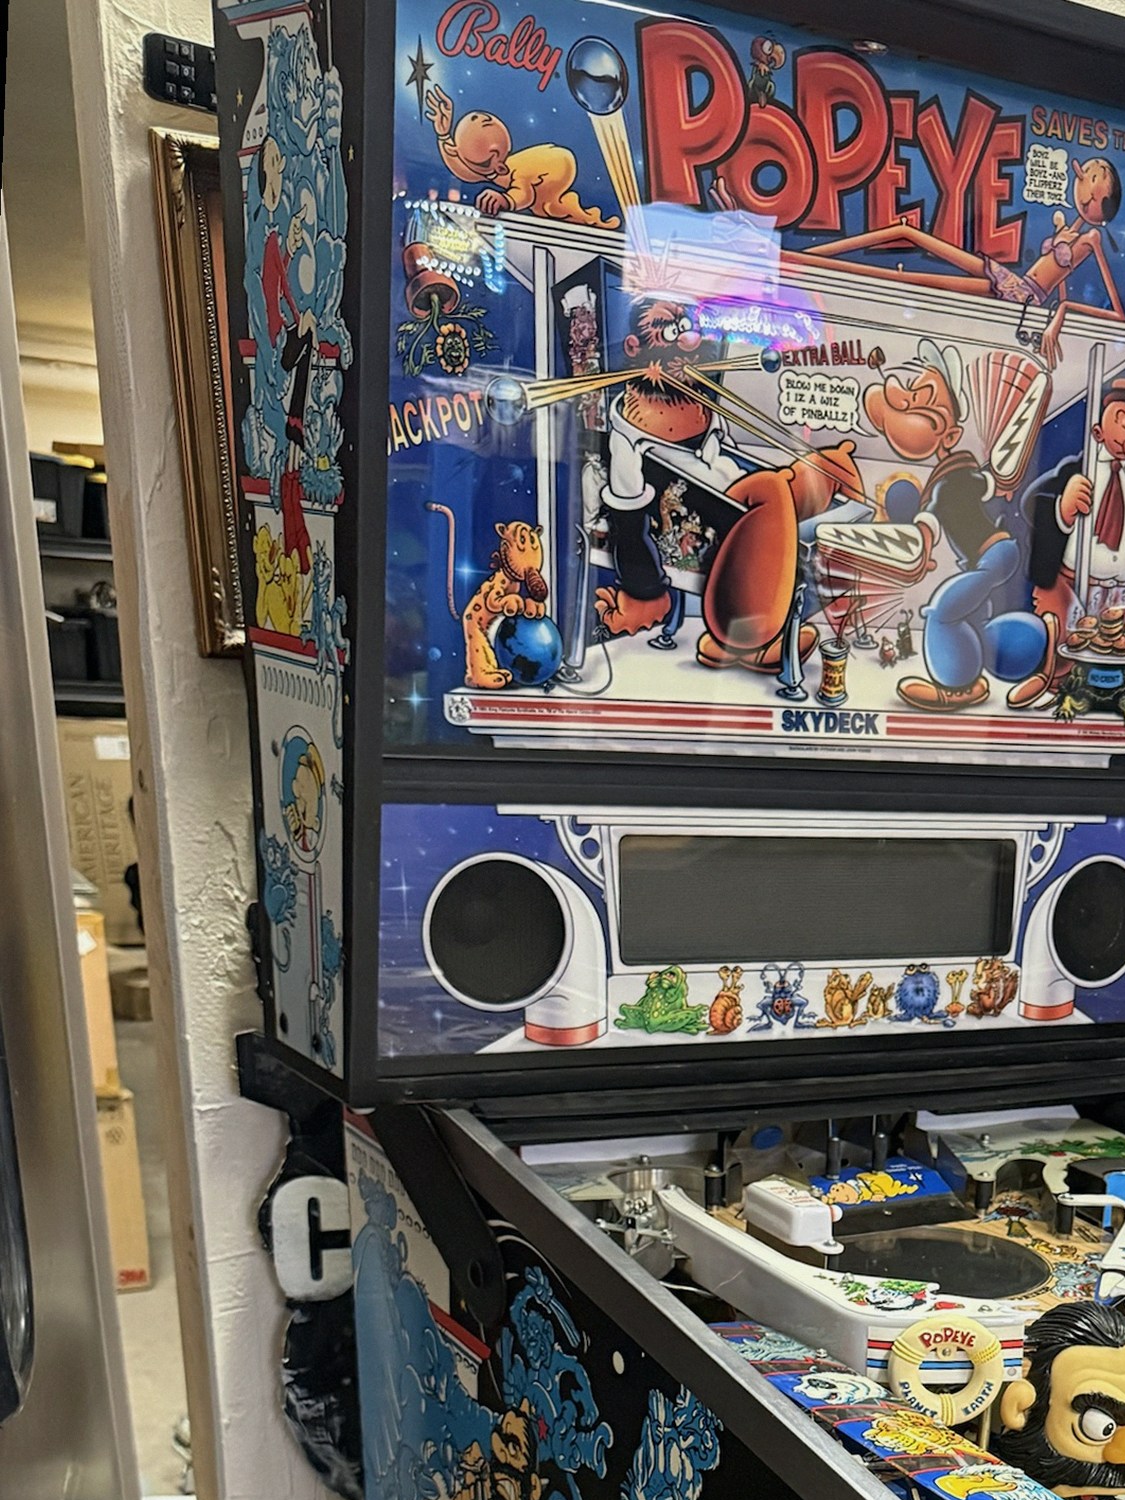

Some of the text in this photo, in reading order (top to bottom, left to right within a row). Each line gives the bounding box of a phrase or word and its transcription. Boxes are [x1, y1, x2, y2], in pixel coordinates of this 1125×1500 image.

[436, 0, 562, 92] Bally
[634, 16, 1027, 263] POPEYE
[1031, 104, 1109, 150] SAVES
[1030, 159, 1059, 171] WILL BE
[1032, 149, 1050, 160] BOYZ
[782, 338, 867, 367] EXTRA BALL
[785, 378, 856, 397] BLOW ME DOWN
[795, 392, 806, 403] IZ
[808, 394, 817, 405] A
[820, 396, 840, 408] WIZ
[782, 405, 797, 417] OF
[781, 709, 880, 735] SKYDECK
[918, 1327, 977, 1349] POPEYE
[899, 1381, 939, 1418] PLANET
[962, 1381, 995, 1416] EARTH
